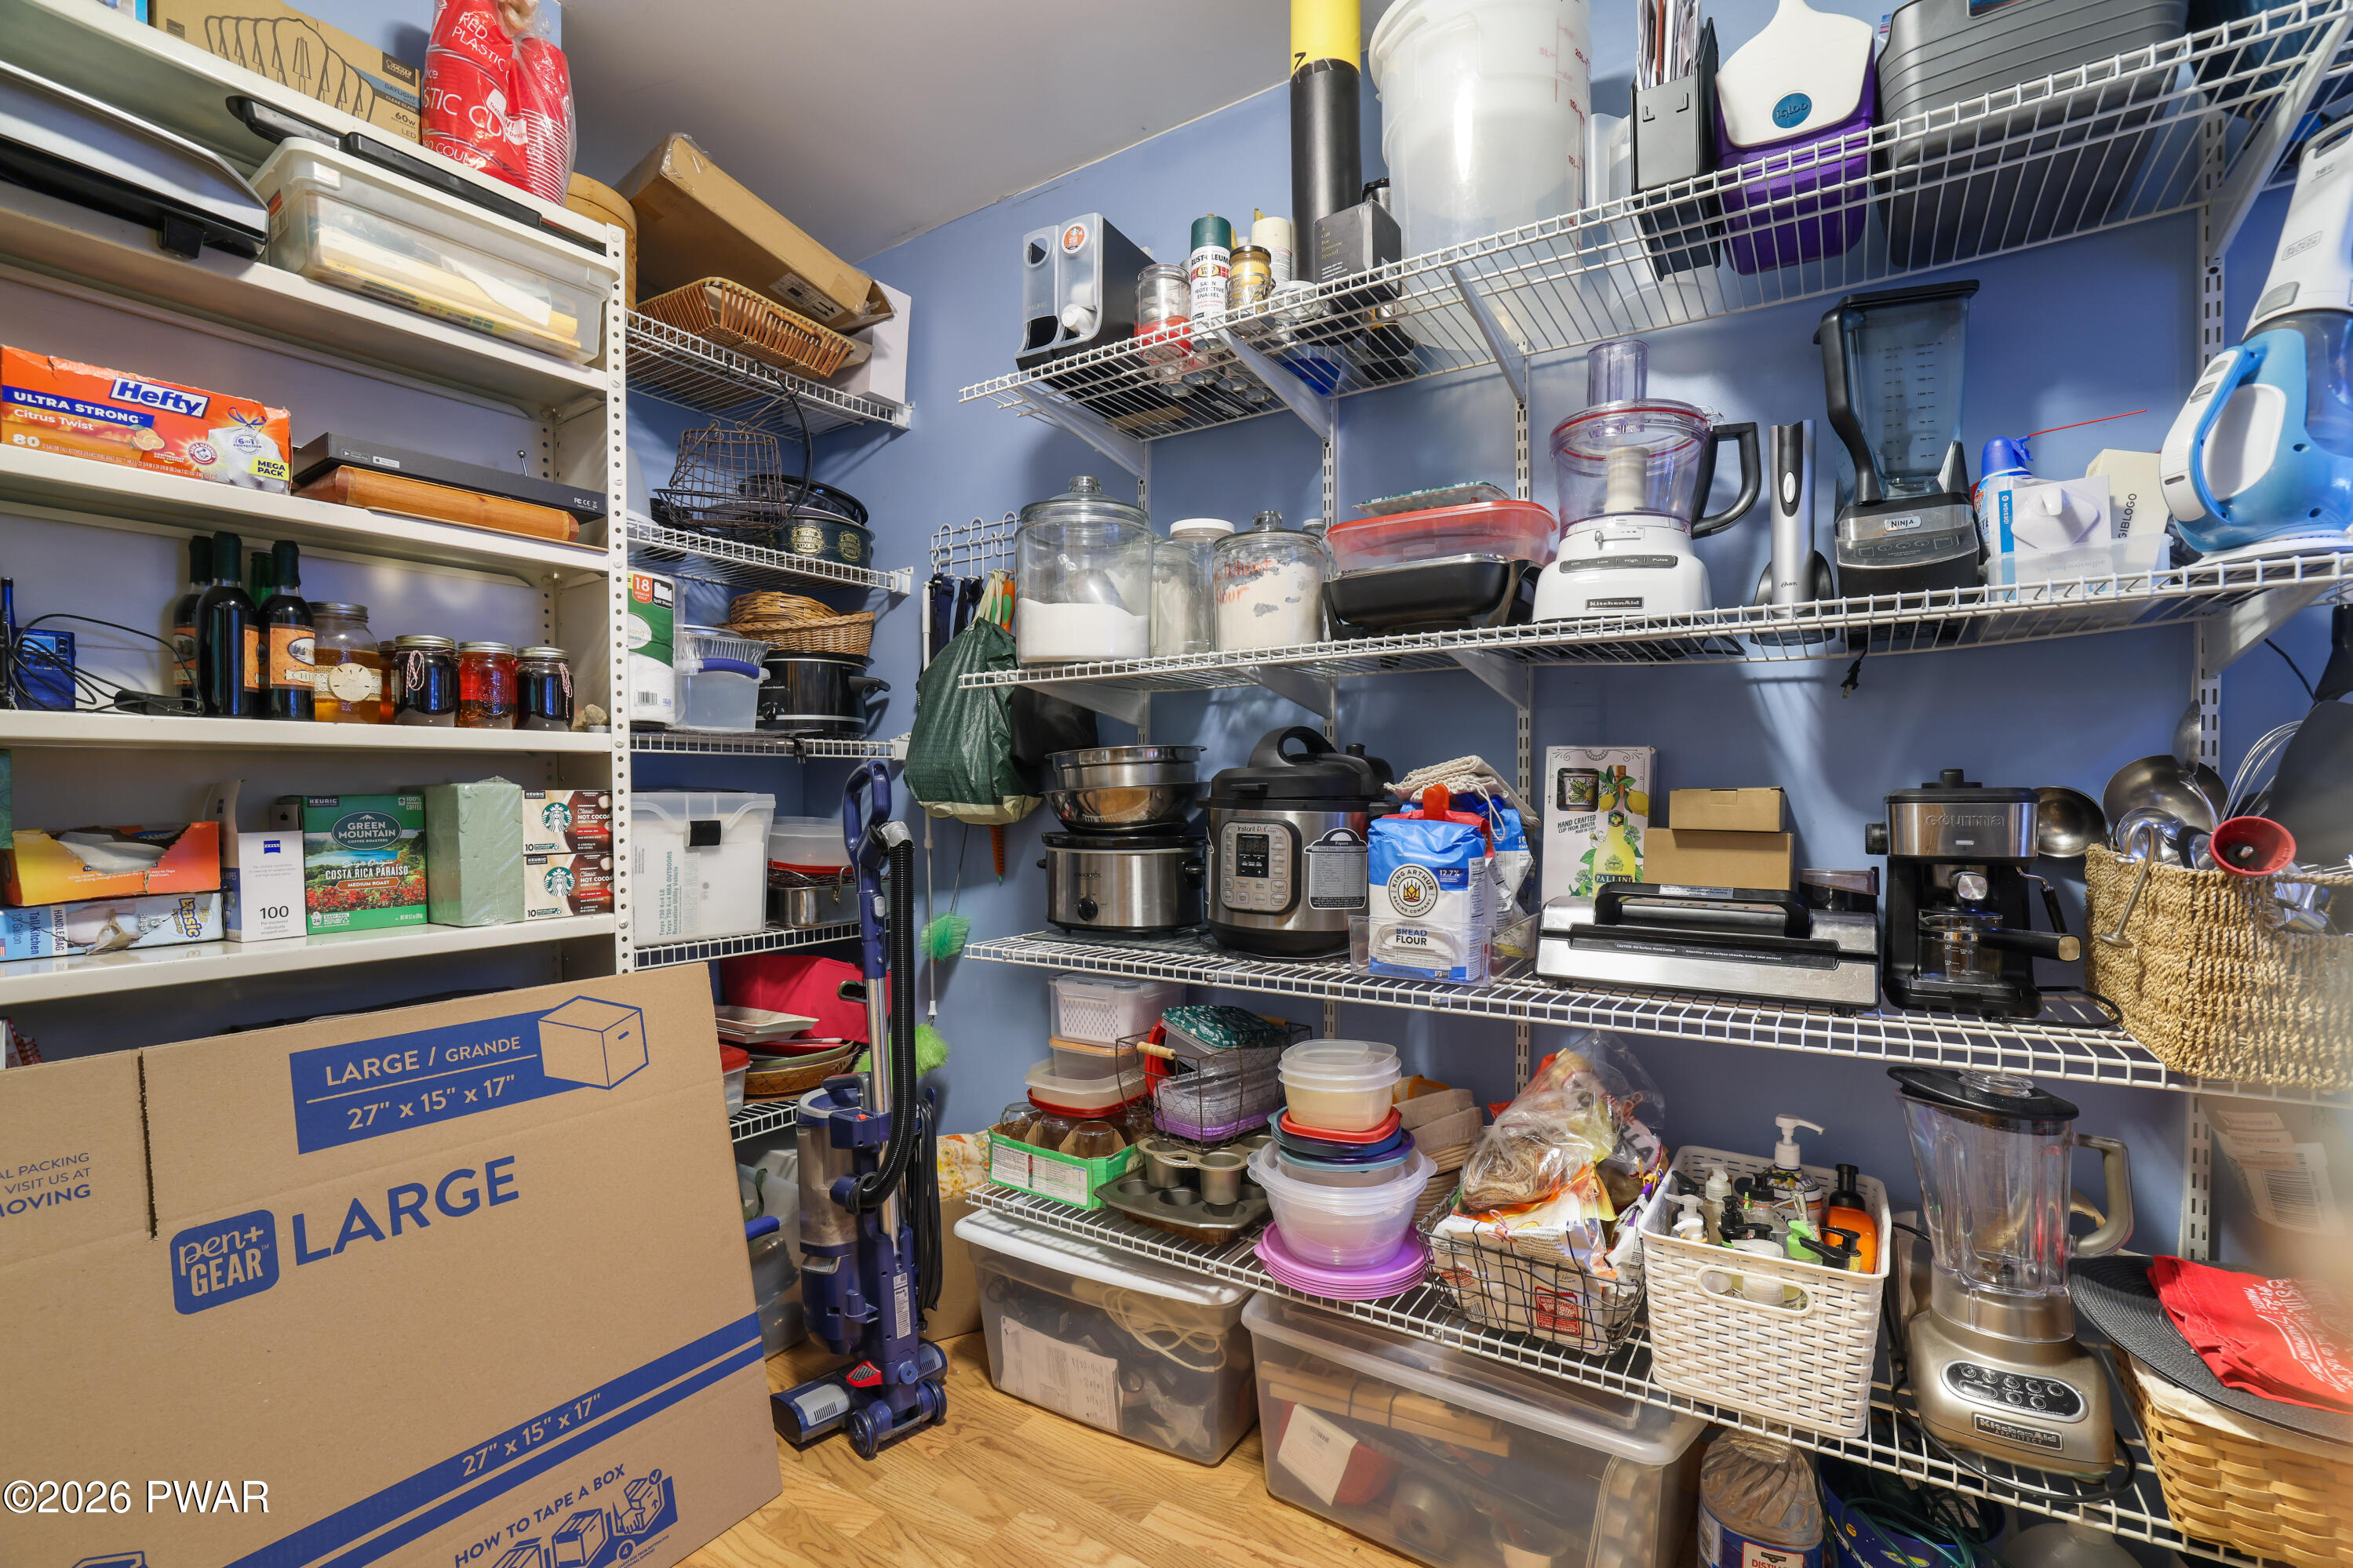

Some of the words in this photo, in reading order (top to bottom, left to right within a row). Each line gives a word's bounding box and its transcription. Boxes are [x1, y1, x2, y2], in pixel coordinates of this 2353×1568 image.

[458, 12, 488, 39] RED
[452, 26, 506, 72] PLASTIC
[384, 83, 416, 101] DAYLIGHT
[1776, 103, 1808, 119] igloo
[401, 128, 417, 139] LED
[14, 391, 70, 410] ULTRA
[117, 380, 202, 416] Hefty
[14, 409, 56, 424] Citrus
[59, 417, 94, 431] Twist
[13, 433, 40, 447] 80
[257, 460, 286, 471] MEGA
[257, 467, 284, 478] PACK
[1891, 518, 1914, 529] NINJA
[635, 577, 650, 591] 18
[1557, 820, 1573, 829] HAND
[1574, 814, 1596, 824] CRAFTED
[338, 829, 396, 839] MOUNTAIN
[326, 869, 352, 880] COSTA
[355, 868, 373, 879] RICA
[376, 864, 410, 876] PARAÍSO
[1393, 871, 1406, 888] KING
[1407, 869, 1434, 891] ARTHUR
[1596, 874, 1633, 883] PALLINI
[260, 905, 290, 919] 100
[1393, 896, 1408, 912] BAKING
[1409, 898, 1432, 914] COMPANY
[53, 909, 64, 935] HANDLE
[138, 912, 148, 931] Bags
[180, 897, 201, 938] Basic
[13, 923, 24, 944] Gallon
[30, 926, 40, 955] Kitchen
[1396, 935, 1427, 945] FLOUR
[1397, 928, 1428, 937] BREAD
[54, 937, 64, 951] BAG
[326, 1050, 420, 1087] LARGE
[445, 1036, 522, 1062] GRANDE
[348, 1101, 391, 1130] 27"
[399, 1102, 414, 1118] x
[421, 1087, 457, 1111] 15"
[464, 1088, 478, 1104] x
[485, 1074, 515, 1097] 17"
[19, 1152, 90, 1177] PACKING
[5, 1177, 45, 1195] VISIT
[49, 1172, 70, 1185] US
[71, 1167, 93, 1183] AT
[292, 1155, 519, 1266] LARGE
[178, 1226, 264, 1277] pen+
[190, 1248, 264, 1297] GEAR
[462, 1439, 498, 1477] 27"
[503, 1436, 519, 1456] x
[522, 1414, 552, 1445] 15"
[557, 1412, 571, 1430] x
[574, 1392, 601, 1421] 17"
[1980, 1418, 2057, 1442] KitchenAid
[1994, 1430, 2043, 1445] ARCHITECT
[454, 1531, 501, 1568] HOW
[506, 1517, 530, 1540] TO
[534, 1491, 575, 1524] TAPE
[577, 1486, 590, 1501] A
[592, 1464, 626, 1492] BOX
